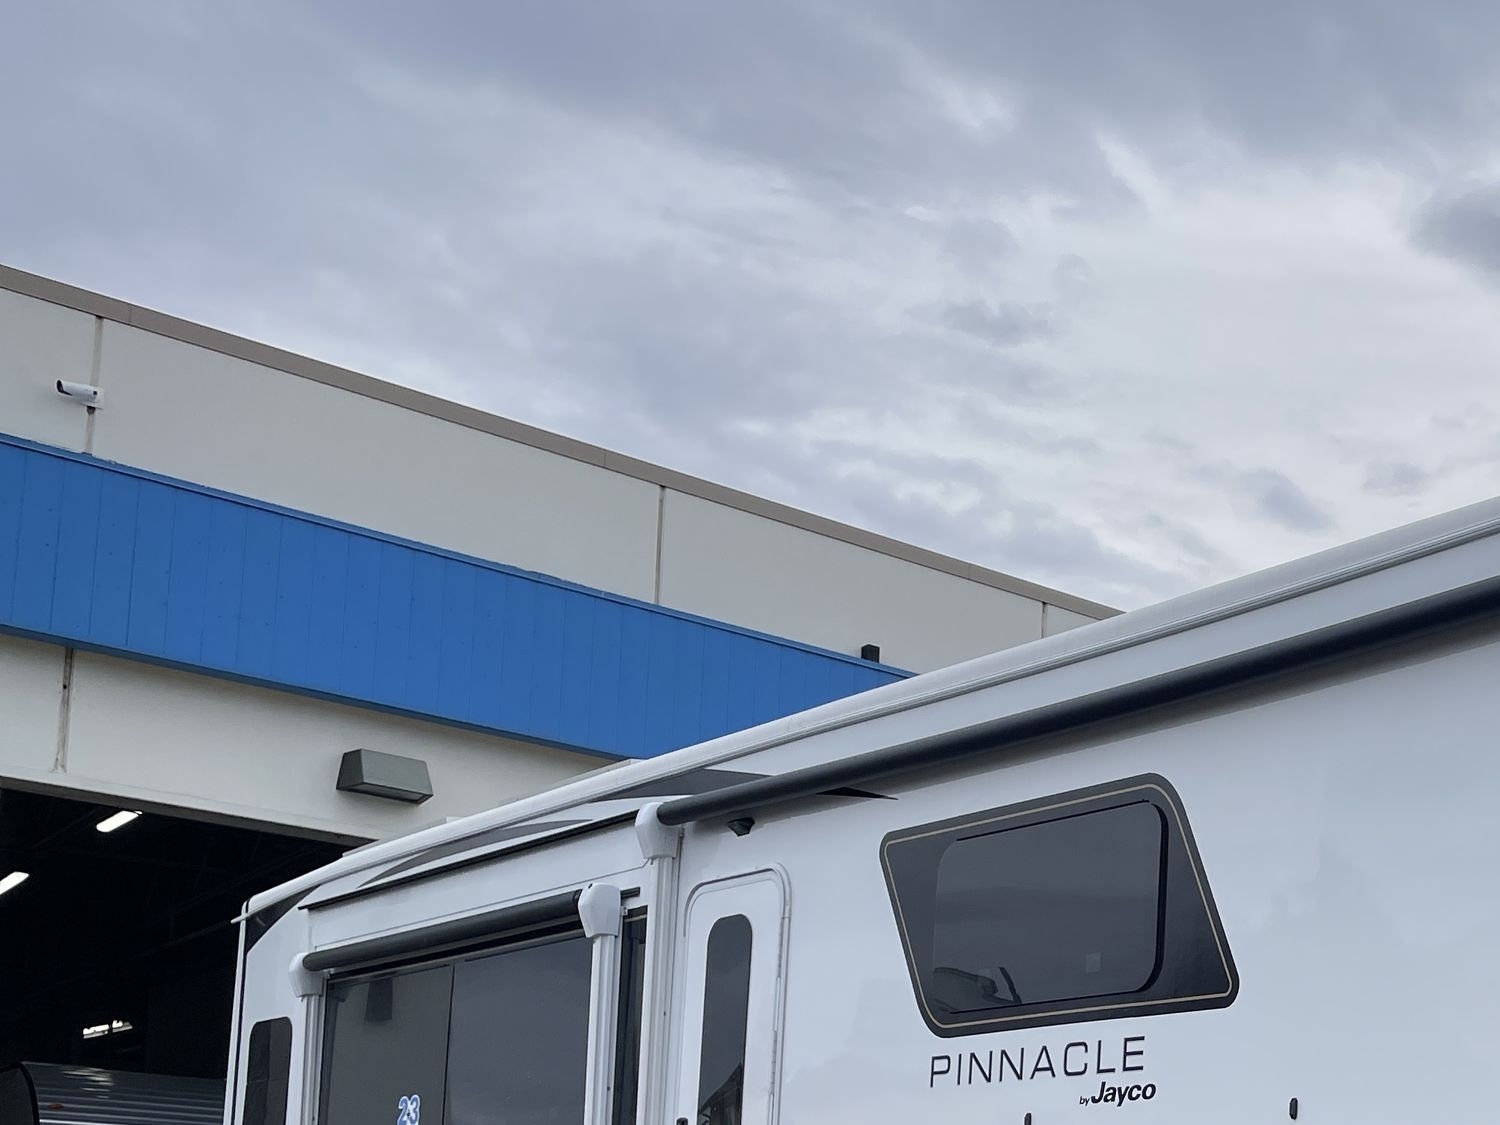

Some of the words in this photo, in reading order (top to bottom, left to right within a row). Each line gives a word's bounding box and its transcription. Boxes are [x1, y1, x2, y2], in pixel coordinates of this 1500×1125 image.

[930, 1035, 1146, 1088] PINNACLE
[1079, 1096, 1091, 1107] by
[1091, 1081, 1157, 1107] Jayco
